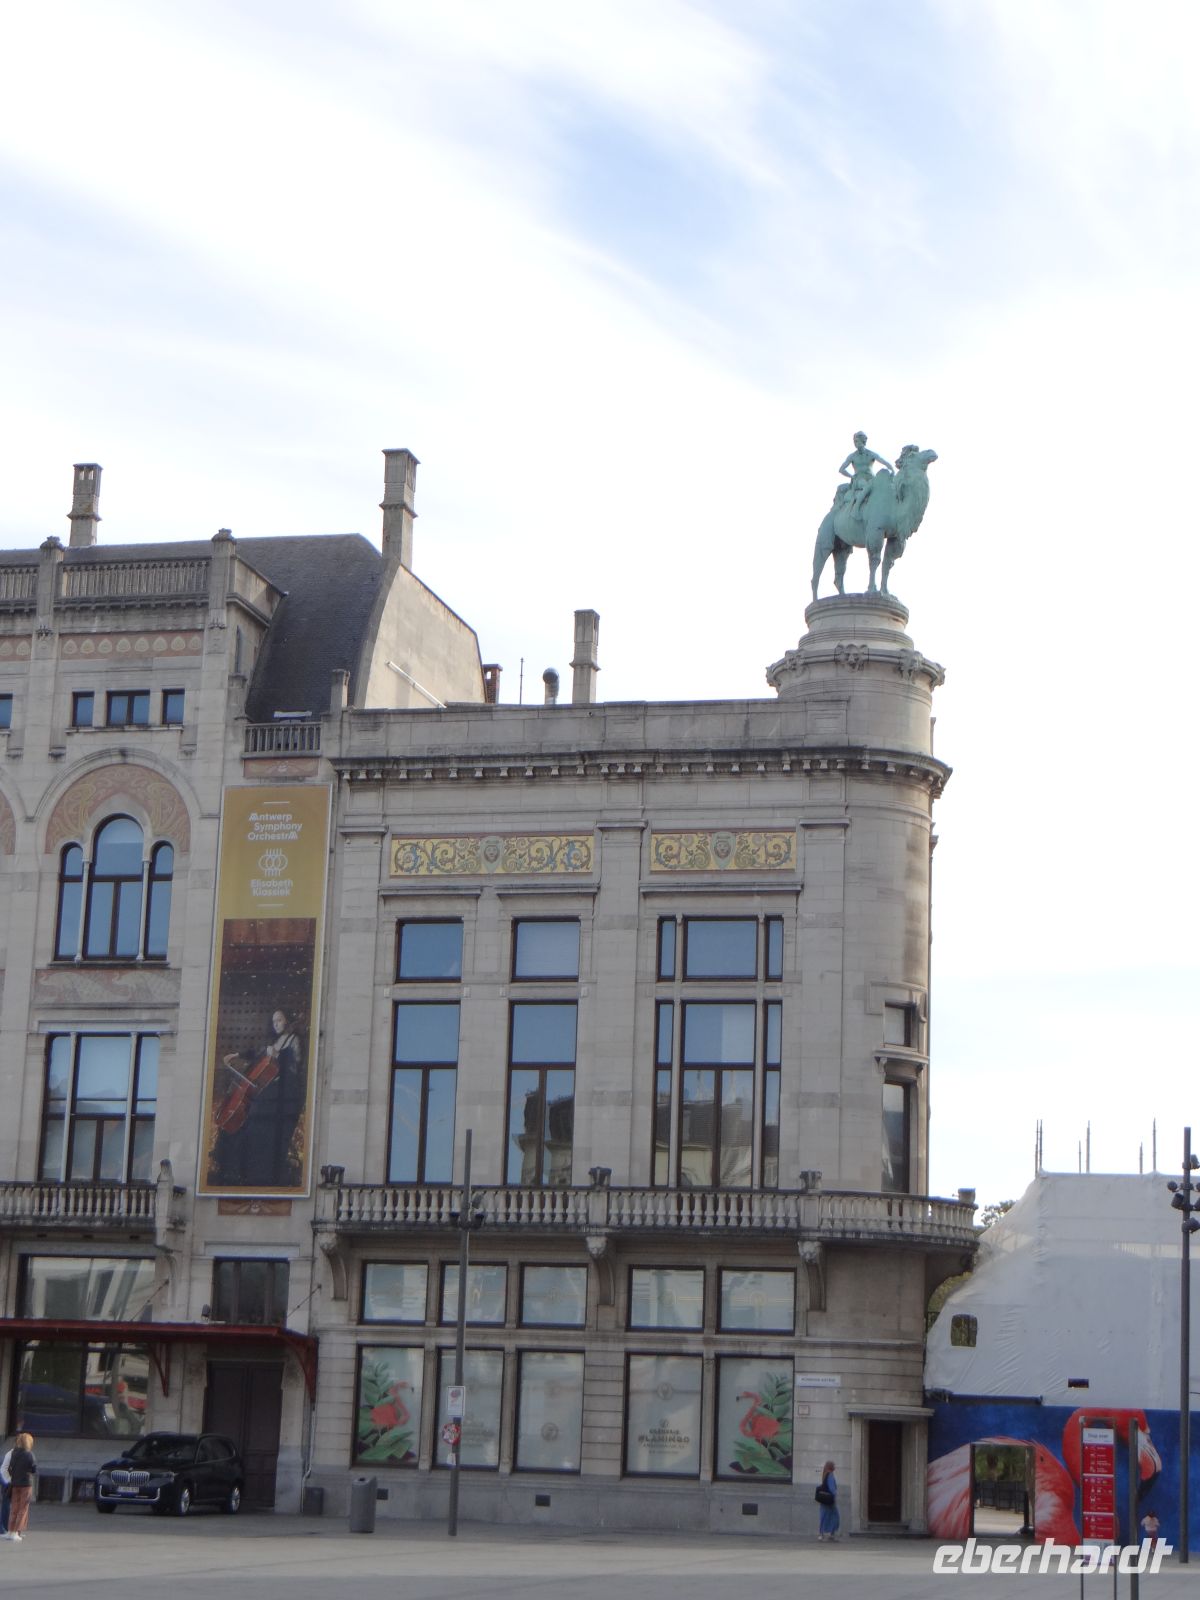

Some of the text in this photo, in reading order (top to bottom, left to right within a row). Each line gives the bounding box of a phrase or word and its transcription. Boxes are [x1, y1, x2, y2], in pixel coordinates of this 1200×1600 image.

[248, 812, 293, 823] Antwerp
[254, 822, 303, 832] Symphony
[250, 879, 294, 888] Elisabeth
[252, 887, 291, 897] Klassiek
